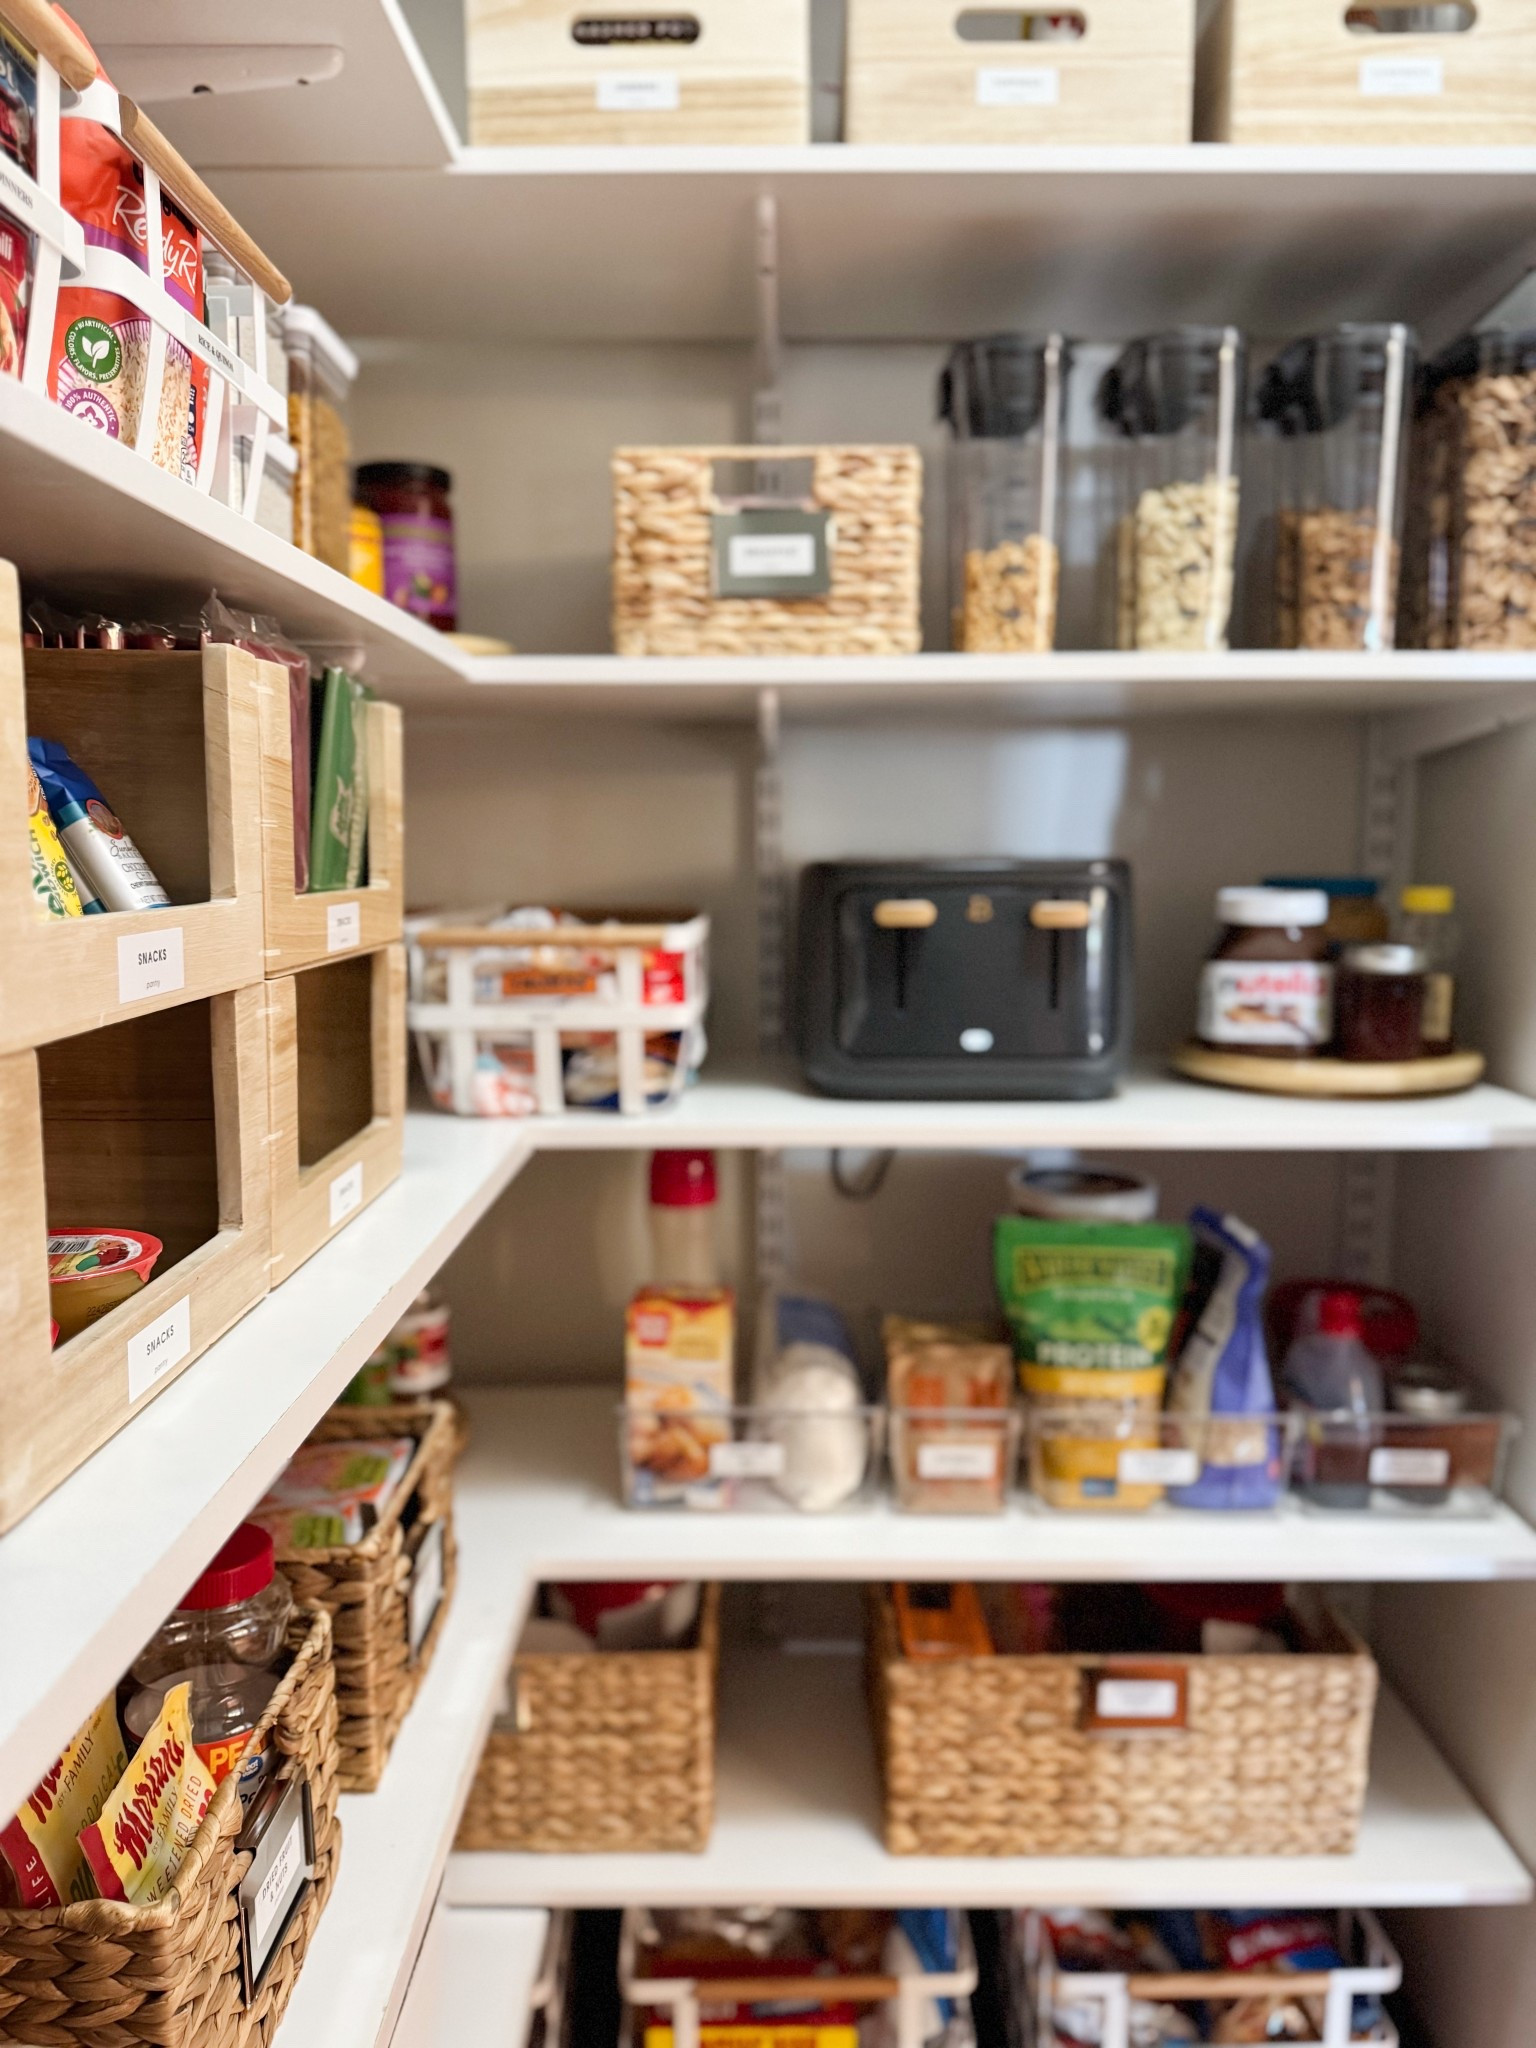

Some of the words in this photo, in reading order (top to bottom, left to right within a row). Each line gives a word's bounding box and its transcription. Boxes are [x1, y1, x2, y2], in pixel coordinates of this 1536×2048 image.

[82, 390, 117, 424] AUTHENTIC
[138, 948, 167, 966] SNACKS
[146, 1324, 175, 1356] SNACKS
[63, 1730, 95, 1793] FAMILY
[156, 1785, 179, 1843] FAMILY
[180, 1774, 202, 1820] DRIED
[262, 1866, 279, 1901] DRIED
